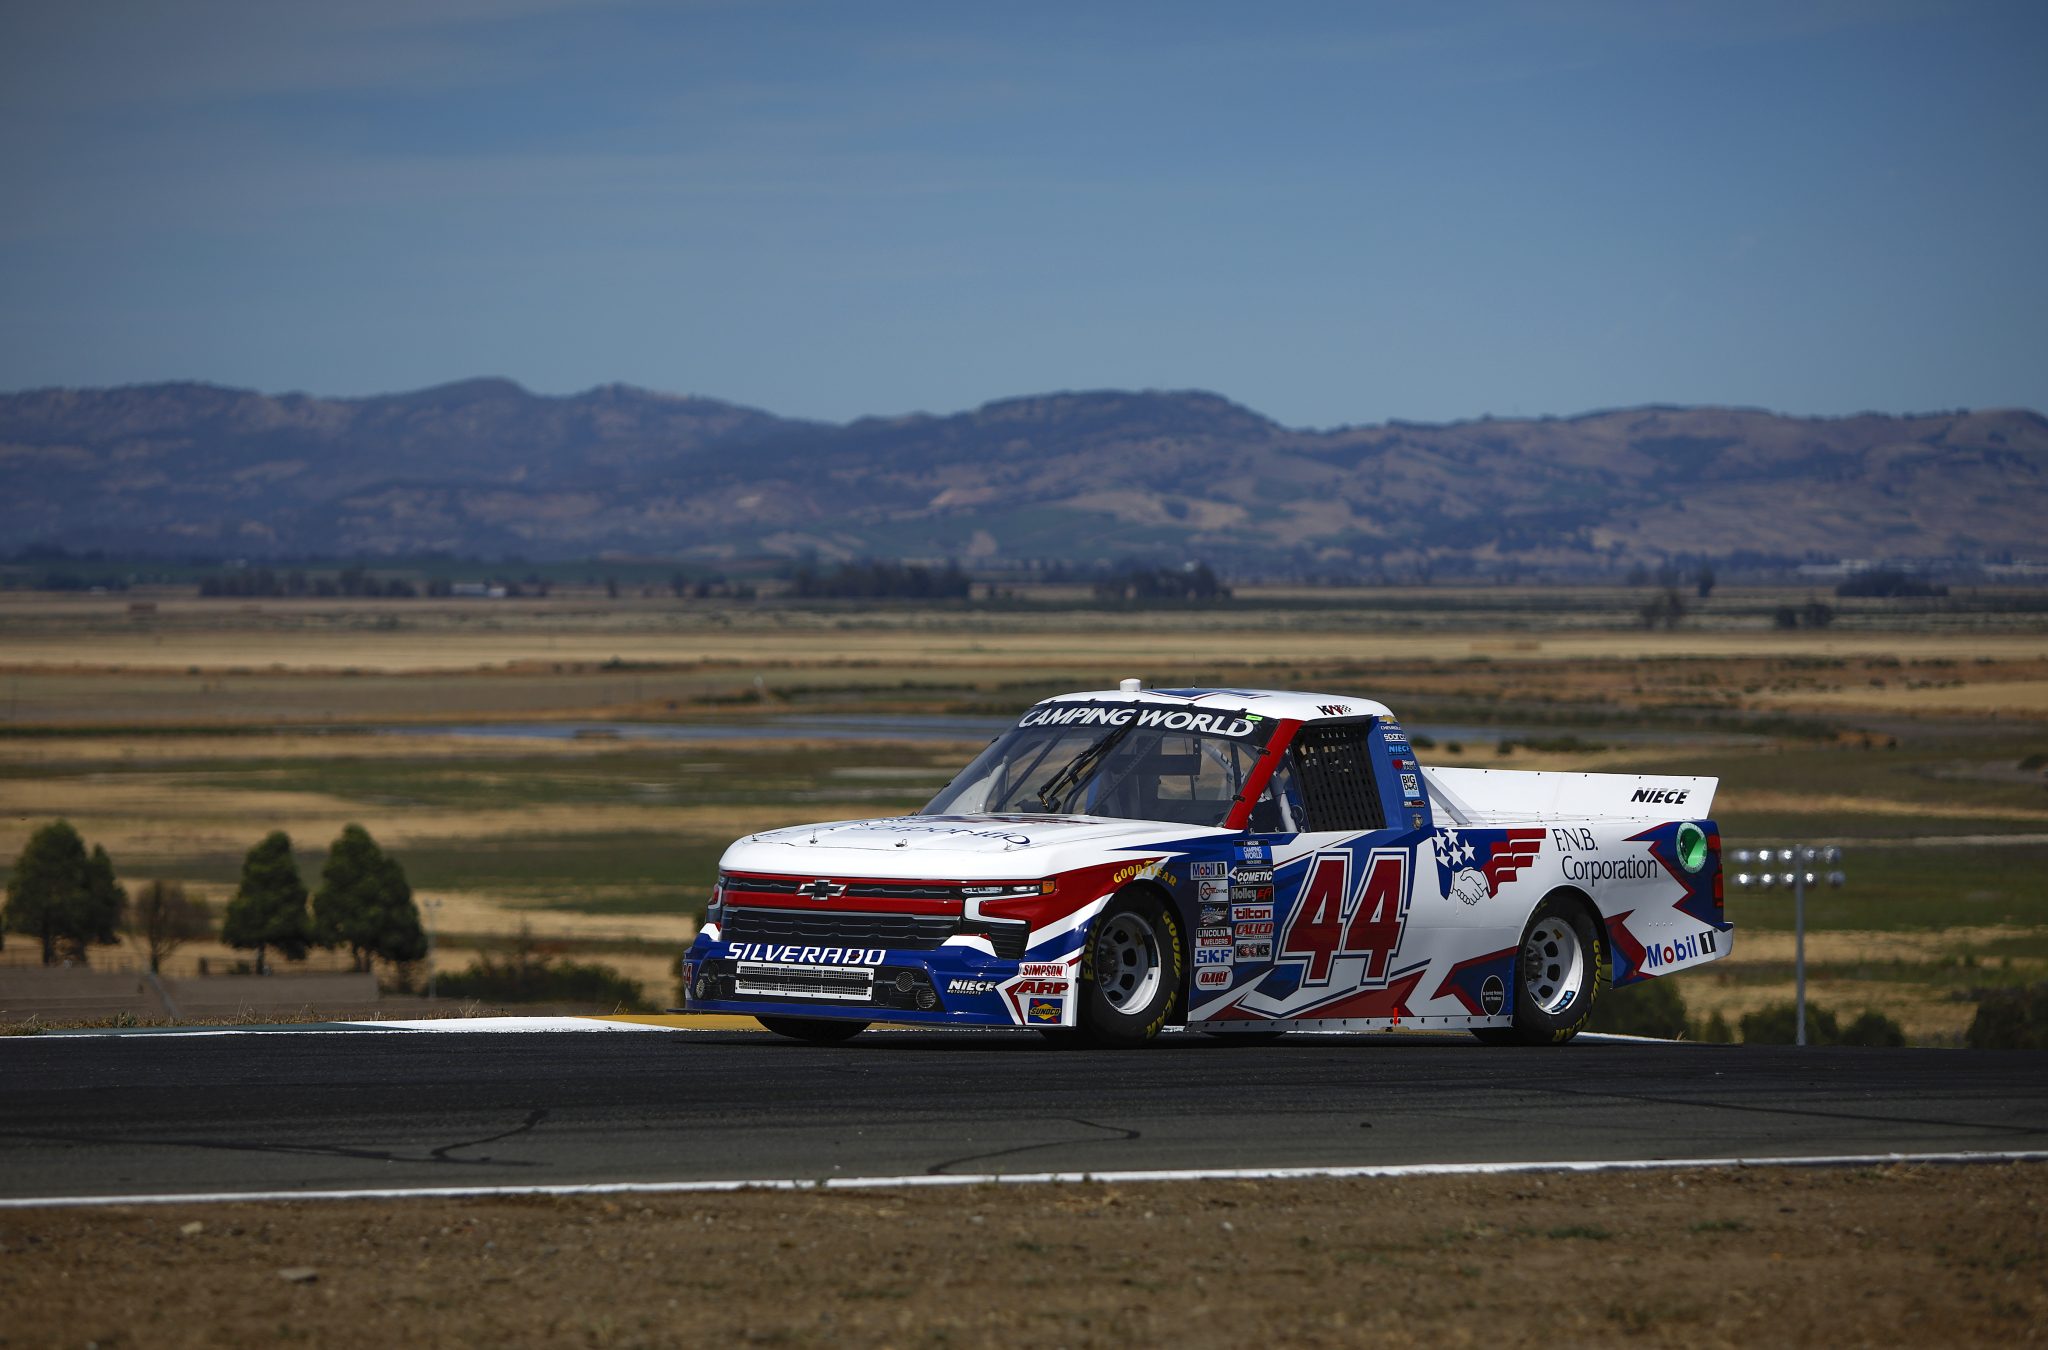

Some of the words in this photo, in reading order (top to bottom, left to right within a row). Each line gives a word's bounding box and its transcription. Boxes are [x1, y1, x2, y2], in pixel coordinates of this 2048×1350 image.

[1018, 706, 1138, 728] CAMPING
[1136, 709, 1255, 738] WORLD
[1402, 775, 1416, 784] BIG
[1630, 787, 1691, 805] NIECE
[1552, 828, 1599, 851] F.N.B.
[1193, 863, 1215, 876] Mobil
[1237, 871, 1273, 882] COMETIC
[1561, 854, 1658, 886] Corporation
[1231, 887, 1256, 901] Holley
[1234, 907, 1271, 920] tilton
[1276, 850, 1408, 987] 44
[1197, 929, 1226, 938] LINCOLN
[1235, 923, 1273, 936] CALICO
[725, 942, 887, 966] SILVERADO
[1196, 949, 1232, 963] SKF
[1646, 934, 1698, 969] Mobil
[1023, 964, 1064, 977] SIMPSON
[948, 978, 996, 992] NIECE
[1016, 981, 1070, 995] ARP
[1030, 1007, 1061, 1016] SUNOCO
